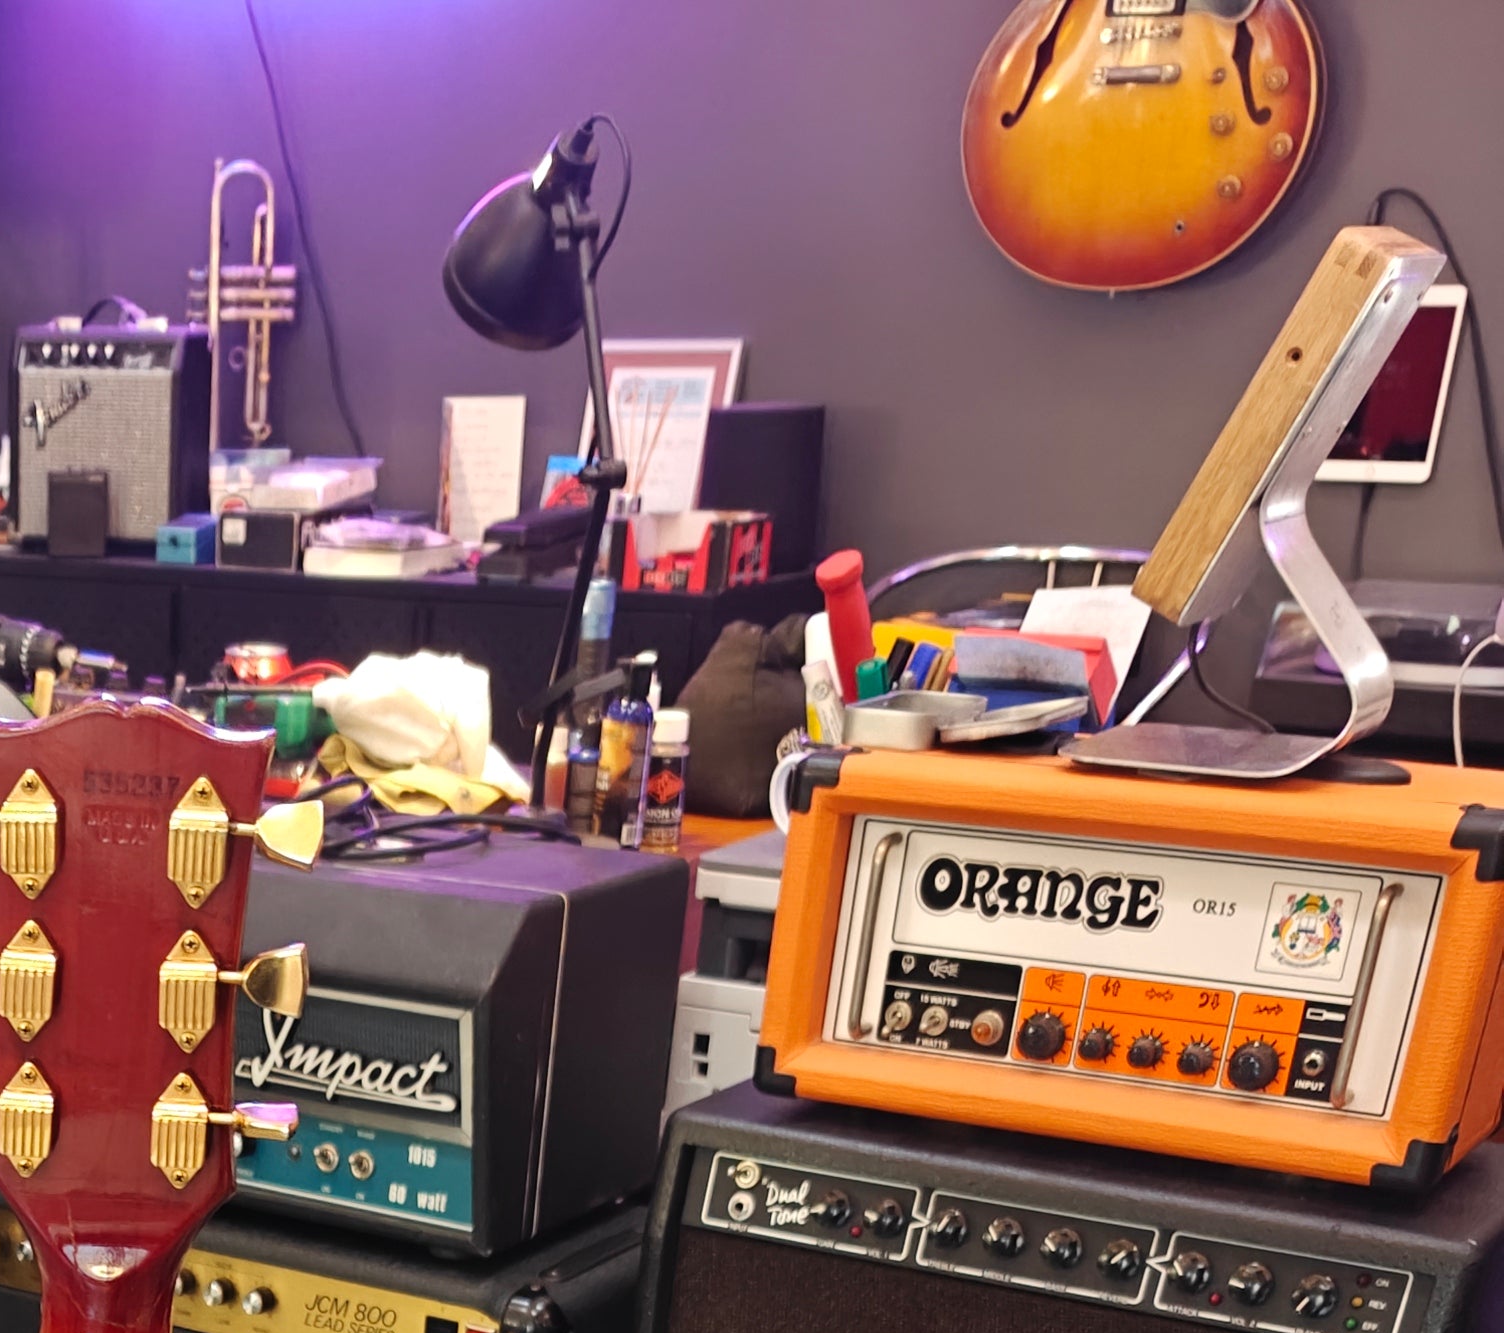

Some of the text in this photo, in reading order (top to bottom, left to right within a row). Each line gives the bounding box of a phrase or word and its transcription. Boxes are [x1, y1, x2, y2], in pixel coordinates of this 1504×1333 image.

[918, 856, 1163, 932] ORANGE
[1192, 898, 1237, 917] OR15
[894, 990, 911, 1001] OFF
[930, 995, 958, 1008] WATTS
[921, 1038, 949, 1050] WATTS
[235, 1006, 457, 1112] Impact
[1294, 1079, 1326, 1093] INPUT
[417, 1191, 447, 1213] watt
[1375, 1278, 1390, 1288] ON
[304, 1294, 397, 1328] JCM 800
[1167, 1304, 1198, 1317] ATTACK
[304, 1312, 345, 1333] LEAD
[1231, 1317, 1247, 1327] VOL
